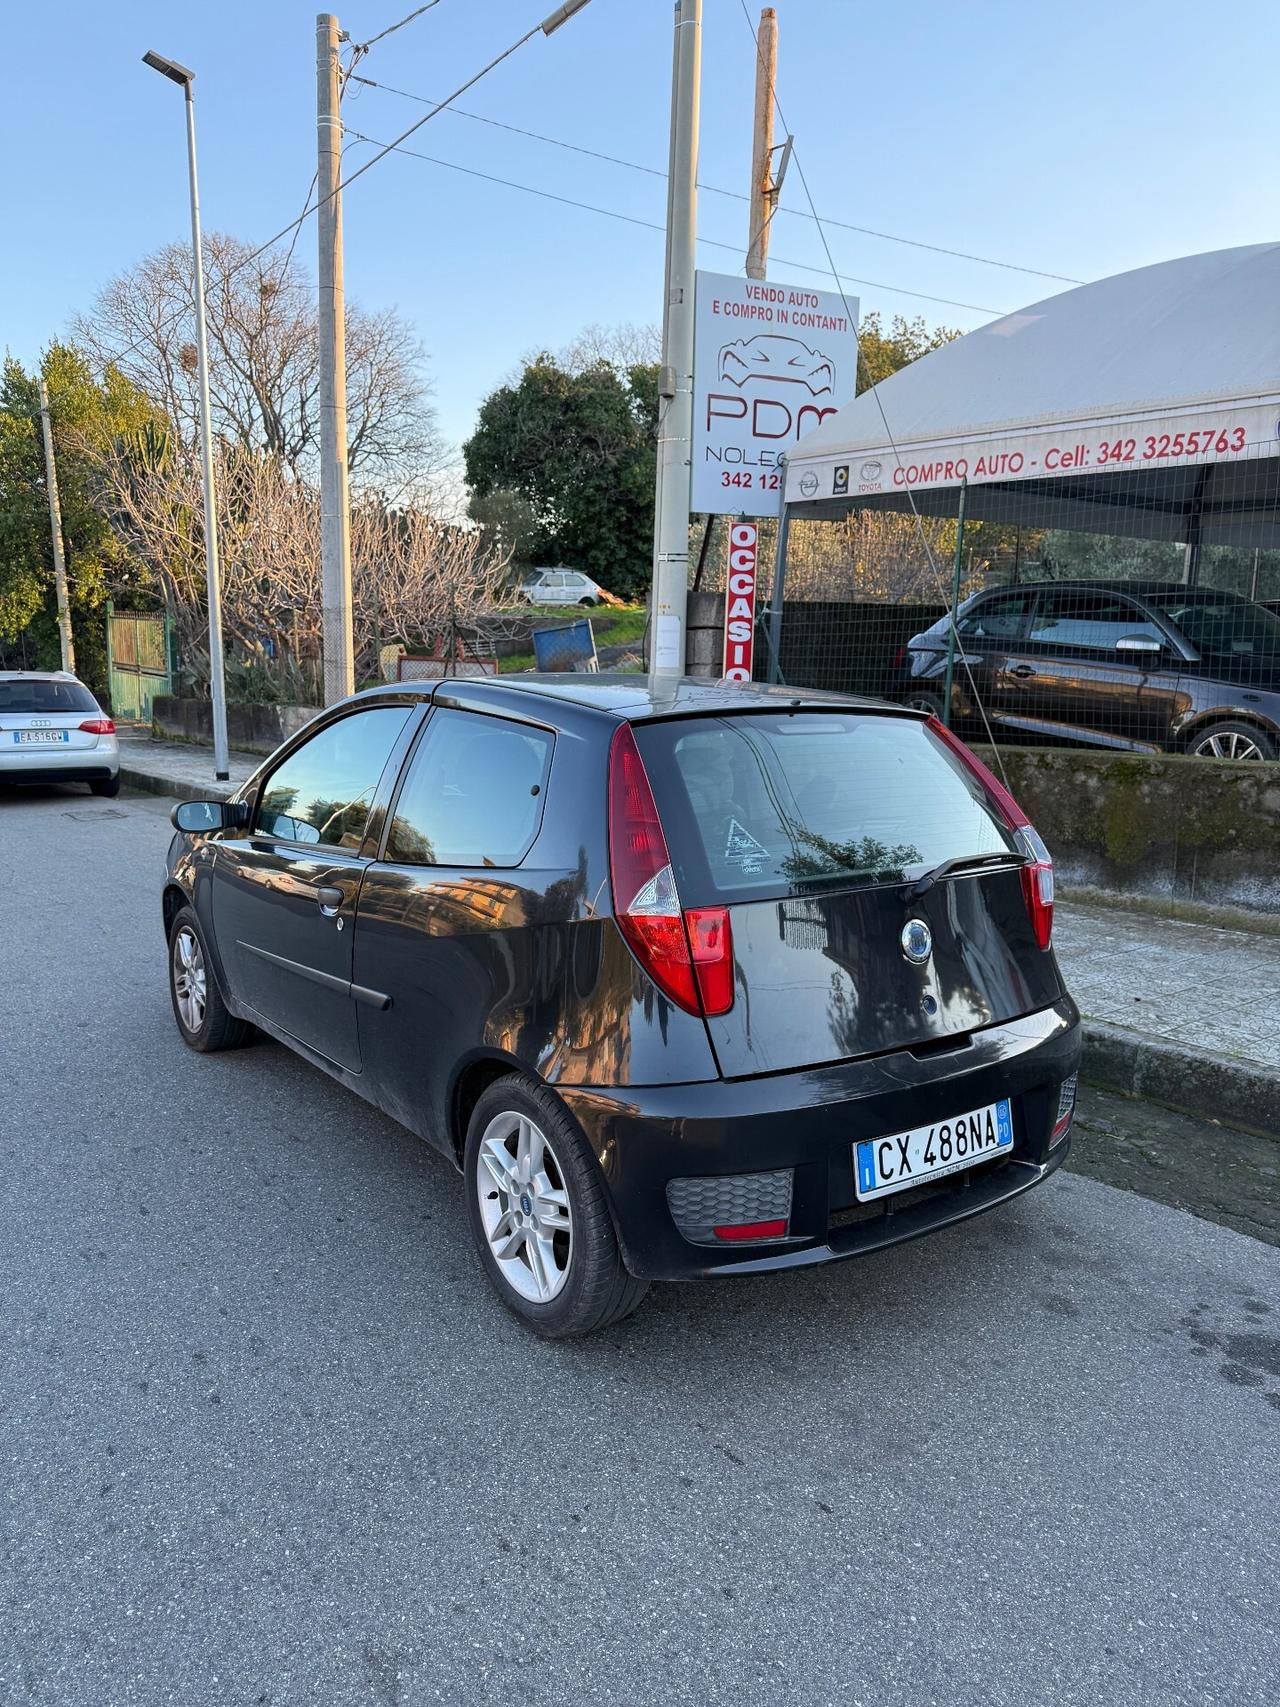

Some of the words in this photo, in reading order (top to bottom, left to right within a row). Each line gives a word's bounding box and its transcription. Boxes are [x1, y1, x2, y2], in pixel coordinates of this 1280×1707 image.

[745, 284, 785, 303] VENDO
[788, 291, 819, 309] AUTO
[712, 300, 720, 314] E
[723, 302, 773, 322] COMPRO
[777, 310, 788, 323] IN
[792, 313, 847, 332] CONTANTI
[893, 458, 968, 485] COMPRO
[973, 452, 1024, 477] AUTO
[1044, 444, 1090, 470] Cell:
[1097, 438, 1136, 464] 342
[1143, 427, 1246, 460] 3255763
[721, 471, 752, 488] 342
[858, 483, 882, 493] TOYOTA
[878, 1135, 912, 1180] CX
[923, 1109, 996, 1166] 488NA
